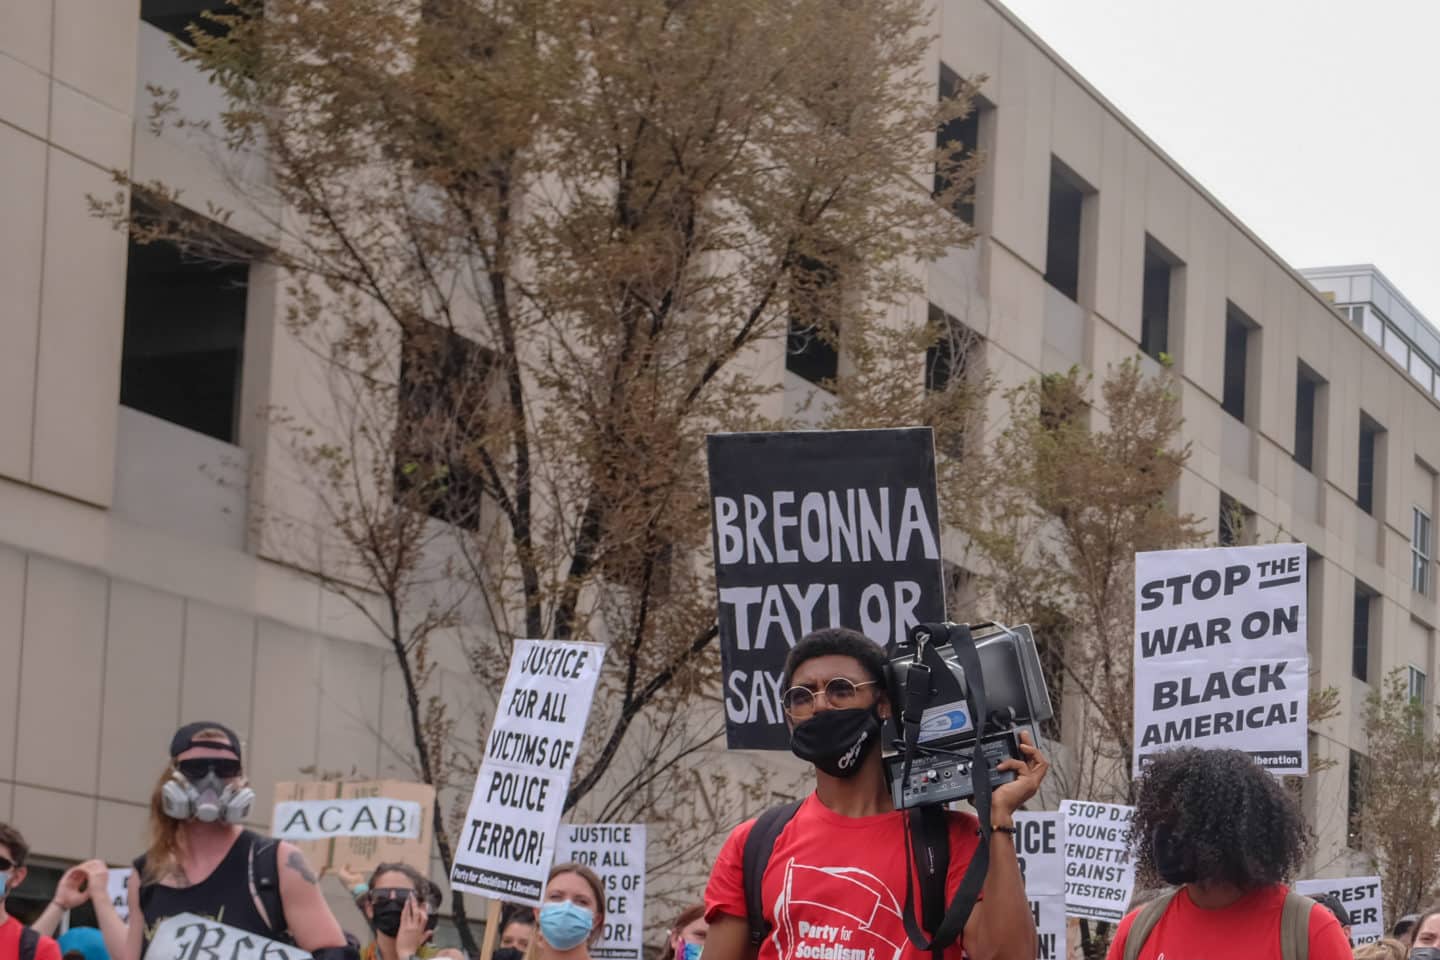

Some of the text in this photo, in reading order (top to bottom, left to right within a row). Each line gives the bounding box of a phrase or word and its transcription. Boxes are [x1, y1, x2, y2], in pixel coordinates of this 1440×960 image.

[714, 487, 939, 565] BREONNA
[1141, 556, 1300, 611] STOP THE
[1141, 605, 1299, 659] WAR ON
[521, 646, 589, 679] JUSTICE
[1152, 661, 1288, 711] BLACK
[507, 688, 567, 723] FOR ALL
[1141, 701, 1298, 747] AMERICA!
[489, 730, 574, 769] VICTIMS OF
[1254, 755, 1298, 766] iberation
[486, 771, 549, 812] POLICE
[282, 805, 407, 833] ACAB
[1068, 803, 1105, 819] STOP
[467, 819, 545, 865] TERROR!
[570, 827, 631, 843] JUSTICE
[571, 851, 629, 866] FOR ALL
[1066, 862, 1125, 883] GAINST
[622, 875, 641, 891] OF
[1065, 882, 1126, 902] OTESTERS!
[798, 921, 853, 943] Party for
